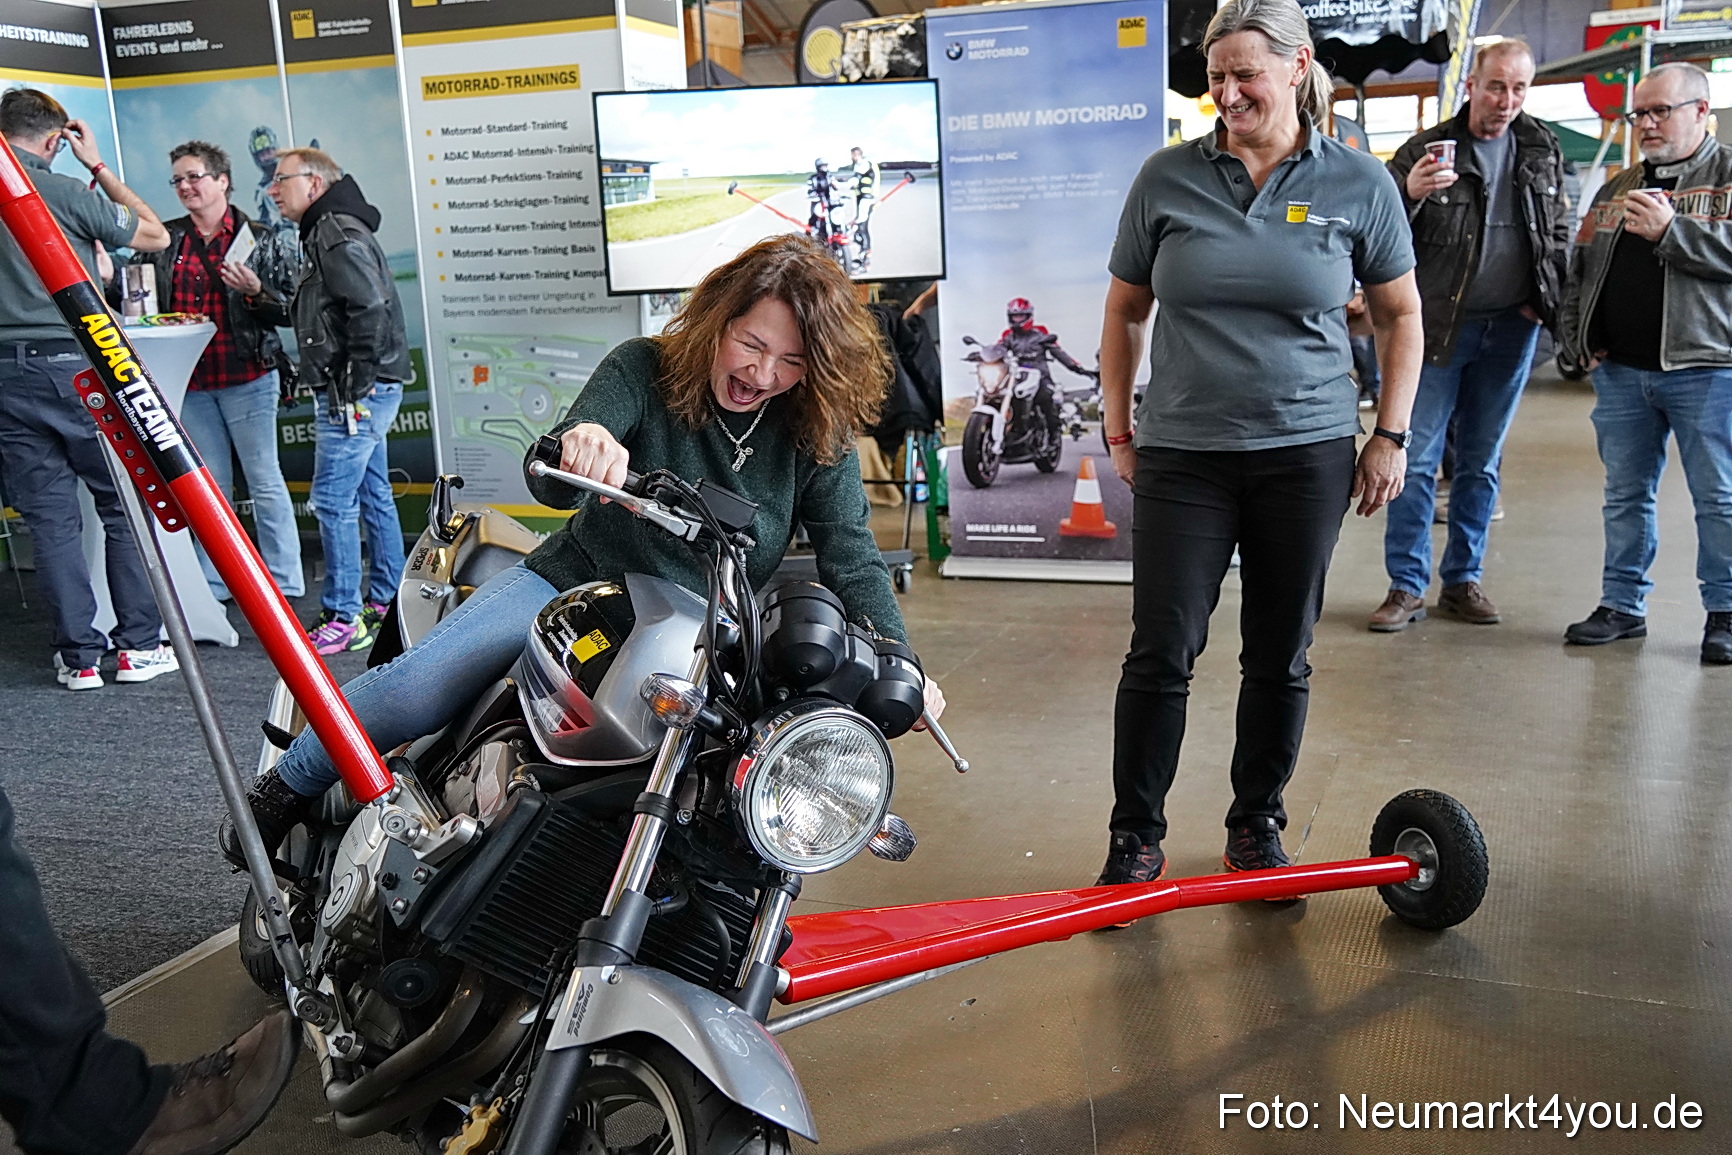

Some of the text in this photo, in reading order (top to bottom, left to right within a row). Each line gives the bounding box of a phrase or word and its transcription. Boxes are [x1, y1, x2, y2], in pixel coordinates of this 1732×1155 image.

[113, 20, 194, 40] FAHRERLEBNIS
[1118, 18, 1146, 29] ADAC
[0, 24, 89, 48] HEITSTRAINING
[968, 38, 996, 49] BMW
[116, 42, 157, 58] EVENTS
[160, 40, 180, 54] und
[181, 38, 209, 52] mehr
[968, 46, 1029, 60] MOTORRAD
[425, 71, 578, 95] MOTORRAD-TRAININGS
[948, 103, 1148, 132] DIE BMW MOTORRAD
[441, 120, 568, 137] Motorrad-Standard-Training
[443, 144, 594, 162] ADAC Motorrad-Intensiv-Training
[445, 170, 583, 186] Motorrad-Perfektions-Training
[450, 220, 566, 234] Motorrad-Kurven-Training
[452, 244, 596, 259] Motorrad-Kurven-Training Basis
[454, 270, 571, 282] Motorrad-Kurven-Training
[115, 390, 149, 442] Nordbayern
[966, 523, 1037, 534] MAKE LIFE A RIDE
[588, 631, 609, 650] ADAC
[574, 983, 594, 1037] Combined
